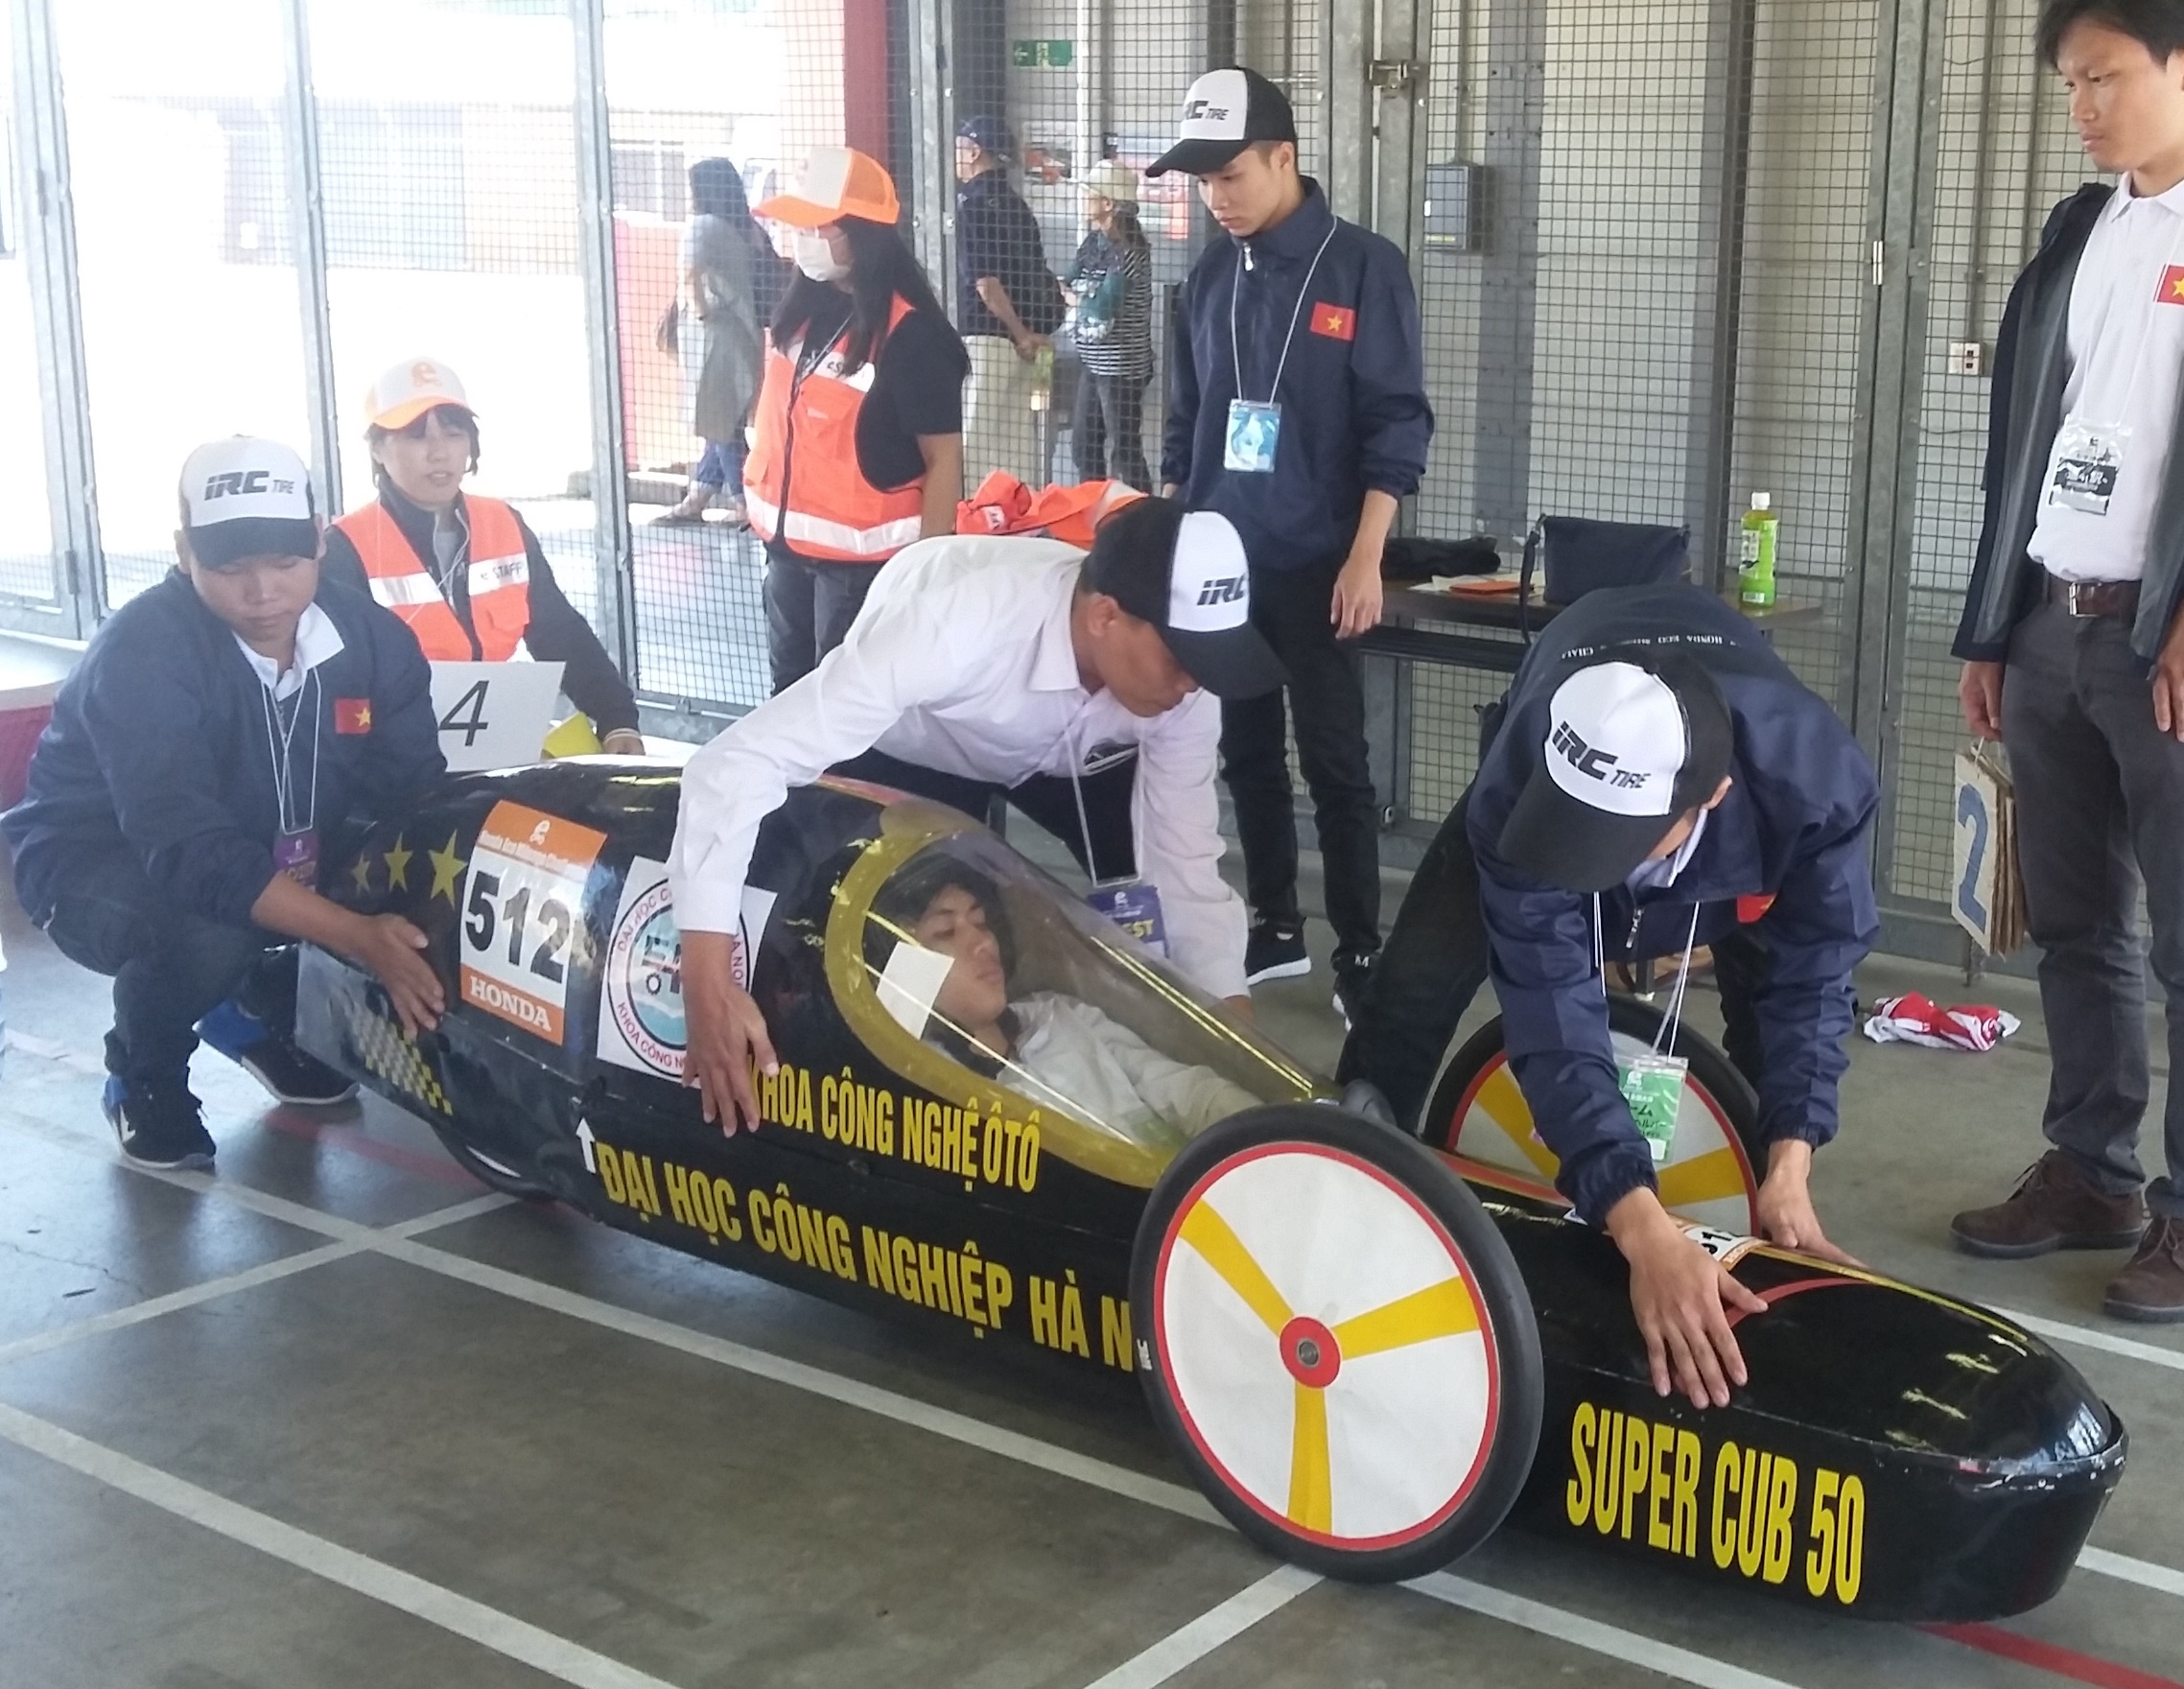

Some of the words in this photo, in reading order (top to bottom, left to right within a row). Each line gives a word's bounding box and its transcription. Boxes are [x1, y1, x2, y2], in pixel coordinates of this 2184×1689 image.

[438, 679, 489, 746] 4
[1958, 783, 1988, 934] 2
[465, 870, 571, 984] 512
[470, 974, 552, 1032] HONDA
[820, 1066, 894, 1156] CÔNG
[903, 1096, 979, 1192] NGHỆ
[982, 1101, 1041, 1193] ÔTÔ
[596, 1142, 662, 1223] ĐẠI
[664, 1161, 741, 1245] HỌC
[748, 1182, 857, 1281] CÔNG
[862, 1225, 1013, 1339] NGHIỆP
[1029, 1268, 1090, 1358] HÀ
[1101, 1295, 1133, 1372] N
[1566, 1401, 1702, 1559] SUPER
[1711, 1441, 1797, 1583] CUB
[1806, 1467, 1865, 1605] 50
